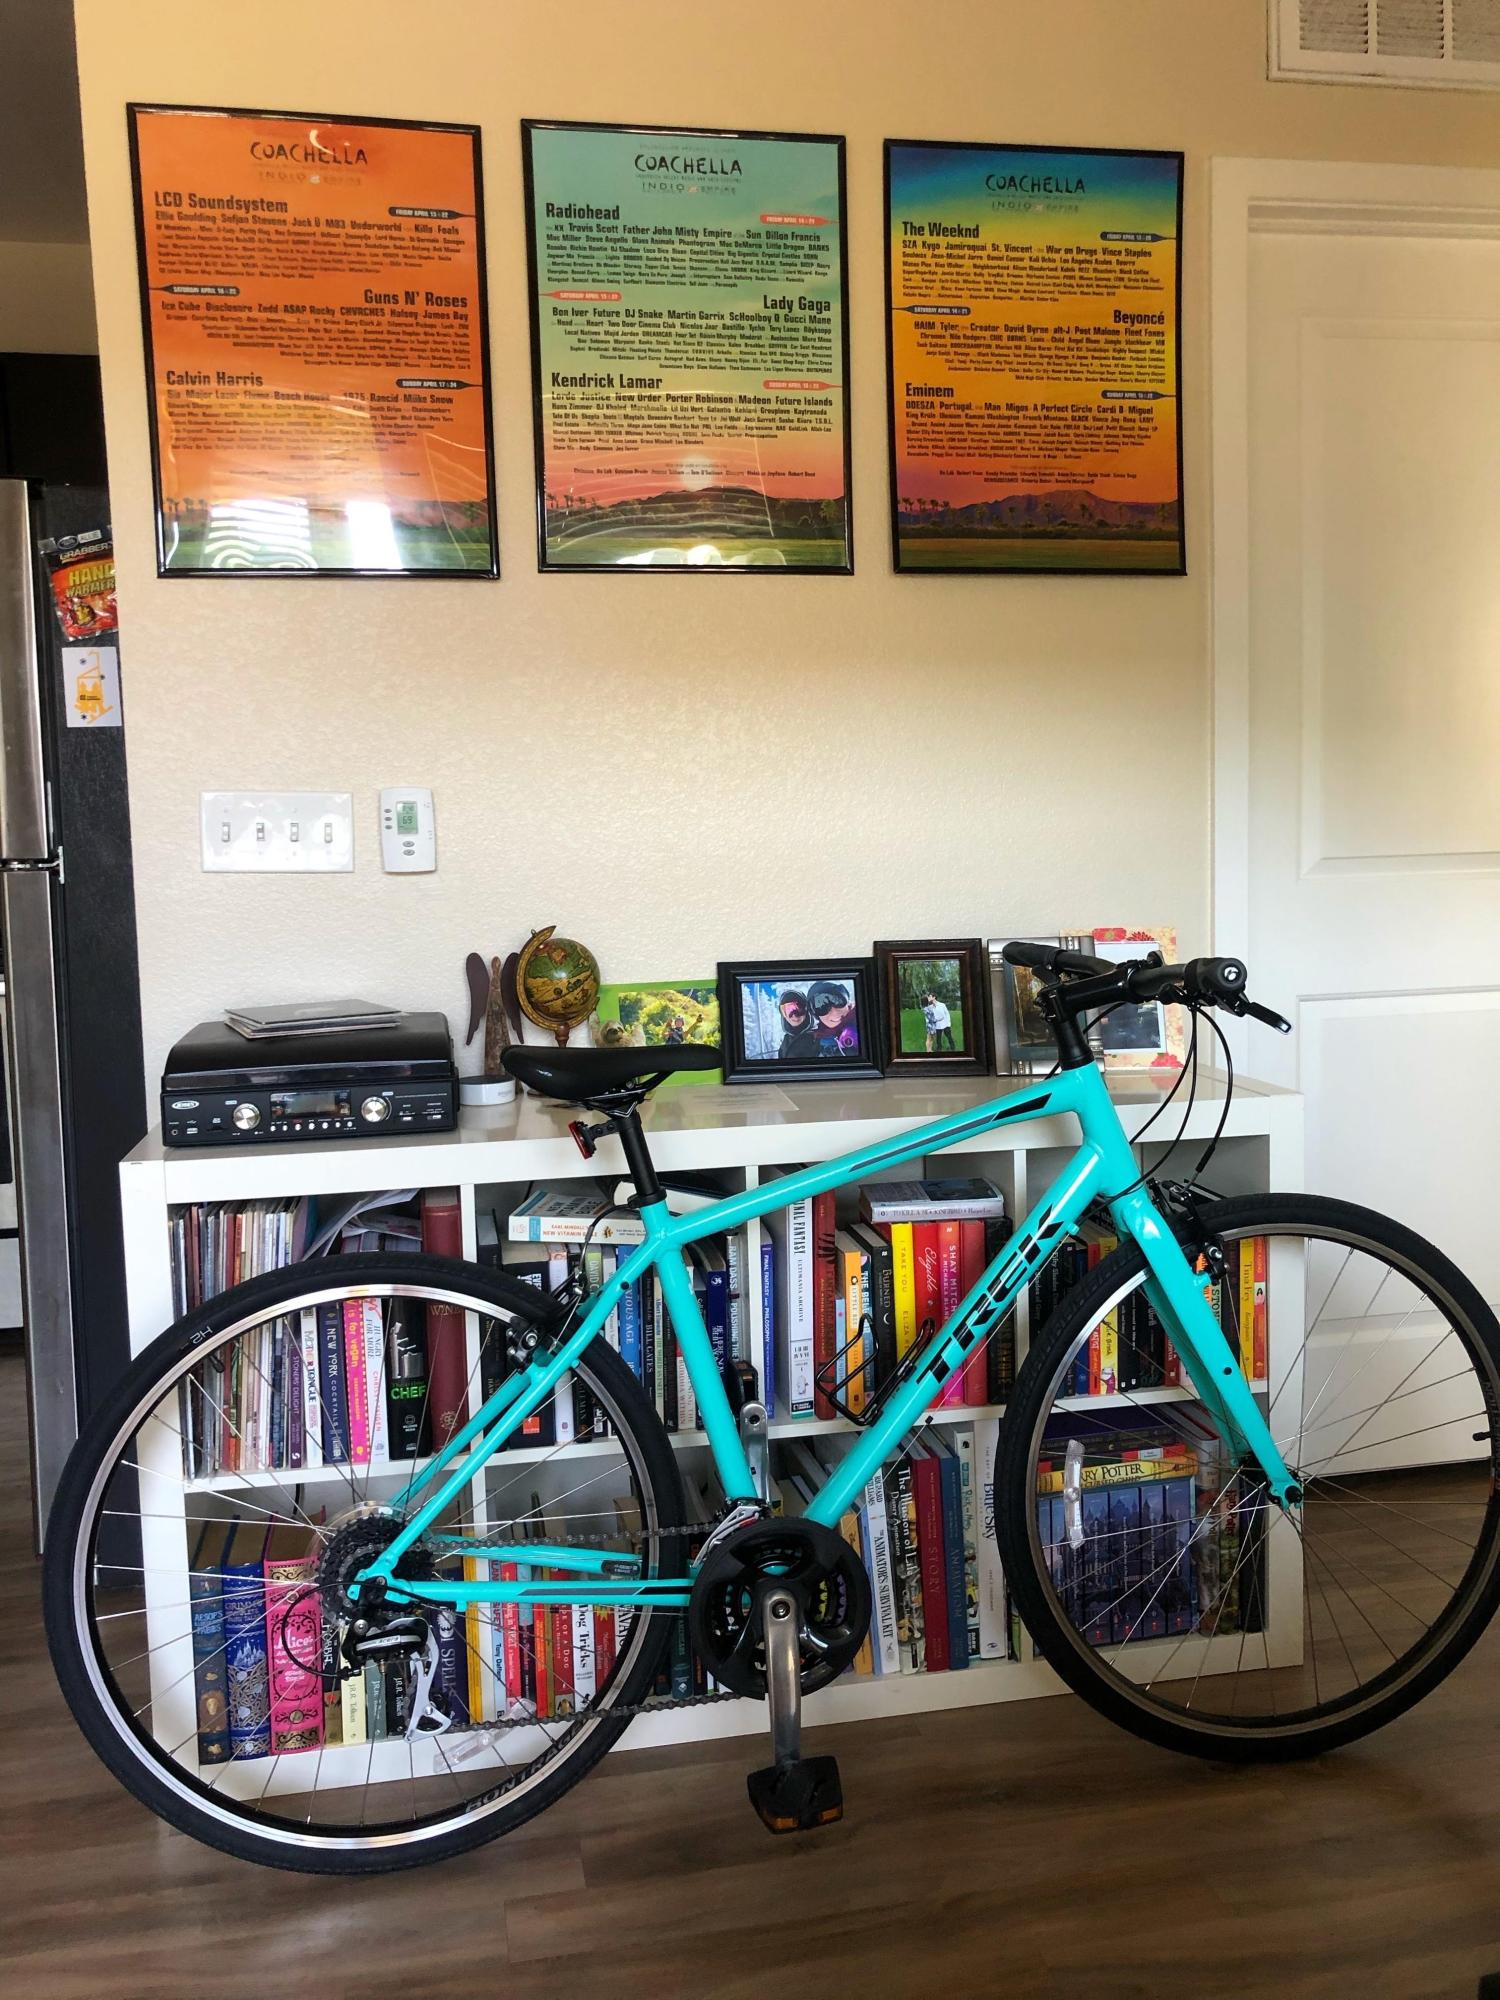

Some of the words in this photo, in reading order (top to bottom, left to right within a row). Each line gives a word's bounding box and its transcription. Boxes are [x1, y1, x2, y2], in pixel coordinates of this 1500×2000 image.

[249, 141, 368, 165] COACHELLA
[634, 154, 743, 176] COACHELLA
[985, 174, 1086, 195] COACHELLA
[154, 190, 183, 208] LCD
[188, 193, 288, 213] Soundsystem
[546, 202, 620, 220] Radiohead
[568, 223, 593, 233] Travis
[596, 224, 619, 234] Scott
[623, 225, 650, 235] Father
[652, 226, 673, 236] John
[675, 227, 699, 238] Misty
[703, 228, 732, 239] Empire
[746, 229, 761, 240] Sun
[766, 231, 788, 241] Dillon
[791, 232, 821, 242] Francis
[902, 221, 925, 237] The
[928, 222, 980, 239] Weeknd
[902, 240, 917, 249] SZA
[921, 241, 941, 252] Kygo
[1045, 245, 1062, 255] War
[1102, 247, 1122, 257] Vince
[364, 288, 400, 306] Guns
[404, 290, 421, 306] N'
[425, 291, 468, 308] Roses
[763, 294, 794, 313] Lady
[798, 296, 831, 315] Gaga
[178, 301, 200, 311] Cube
[205, 302, 253, 314] Disclosure
[422, 309, 450, 320] James
[552, 306, 569, 317] Bon
[571, 307, 589, 317] Iver
[593, 307, 620, 318] Future
[625, 308, 635, 318] DJ
[638, 309, 663, 319] Snake
[667, 309, 696, 320] Martin
[699, 310, 725, 320] Garrix
[729, 311, 772, 324] ScHoolboy
[783, 313, 807, 324] Gucci
[808, 314, 832, 325] Mane
[1113, 309, 1165, 327] Beyoncé
[914, 321, 936, 331] HAIM
[970, 322, 1000, 333] Creator
[1004, 323, 1025, 333] David
[1027, 324, 1049, 335] Byrne
[1074, 326, 1091, 335] Post
[166, 370, 211, 386] Calvin
[215, 371, 264, 387] Harris
[551, 372, 615, 389] Kendrick
[619, 373, 663, 390] Lamar
[665, 393, 694, 403] Porter
[695, 394, 734, 405] Robinson
[738, 395, 772, 405] Madeon
[775, 396, 802, 406] Future
[804, 396, 833, 407] Islands
[905, 382, 954, 398] Eminem
[984, 402, 1001, 411] Man
[1040, 404, 1069, 414] Perfect
[1070, 404, 1093, 414] Circle
[1096, 405, 1117, 414] Cardi
[1128, 406, 1153, 416] Miguel
[60, 542, 108, 560] GRABBER
[69, 563, 115, 586] HAND
[949, 1245, 957, 1273] SHAY
[730, 1265, 739, 1290] DASS
[918, 1246, 938, 1295] Eligible
[882, 1268, 893, 1308] BURNED
[916, 1203, 1065, 1384] TREK
[348, 1322, 357, 1335] for
[731, 1302, 740, 1341] POLISHING
[326, 1328, 337, 1350] NEW
[350, 1339, 360, 1368] vegan
[328, 1353, 339, 1378] YORK
[331, 1380, 339, 1427] COCKTAILS
[391, 1386, 426, 1400] CHEF
[898, 1466, 911, 1491] The
[1101, 1463, 1145, 1480] POTTER
[900, 1493, 914, 1536] Illusion
[904, 1539, 913, 1549] of
[905, 1551, 919, 1576] Life
[576, 1604, 589, 1628] Dog
[579, 1630, 592, 1669] Tricks
